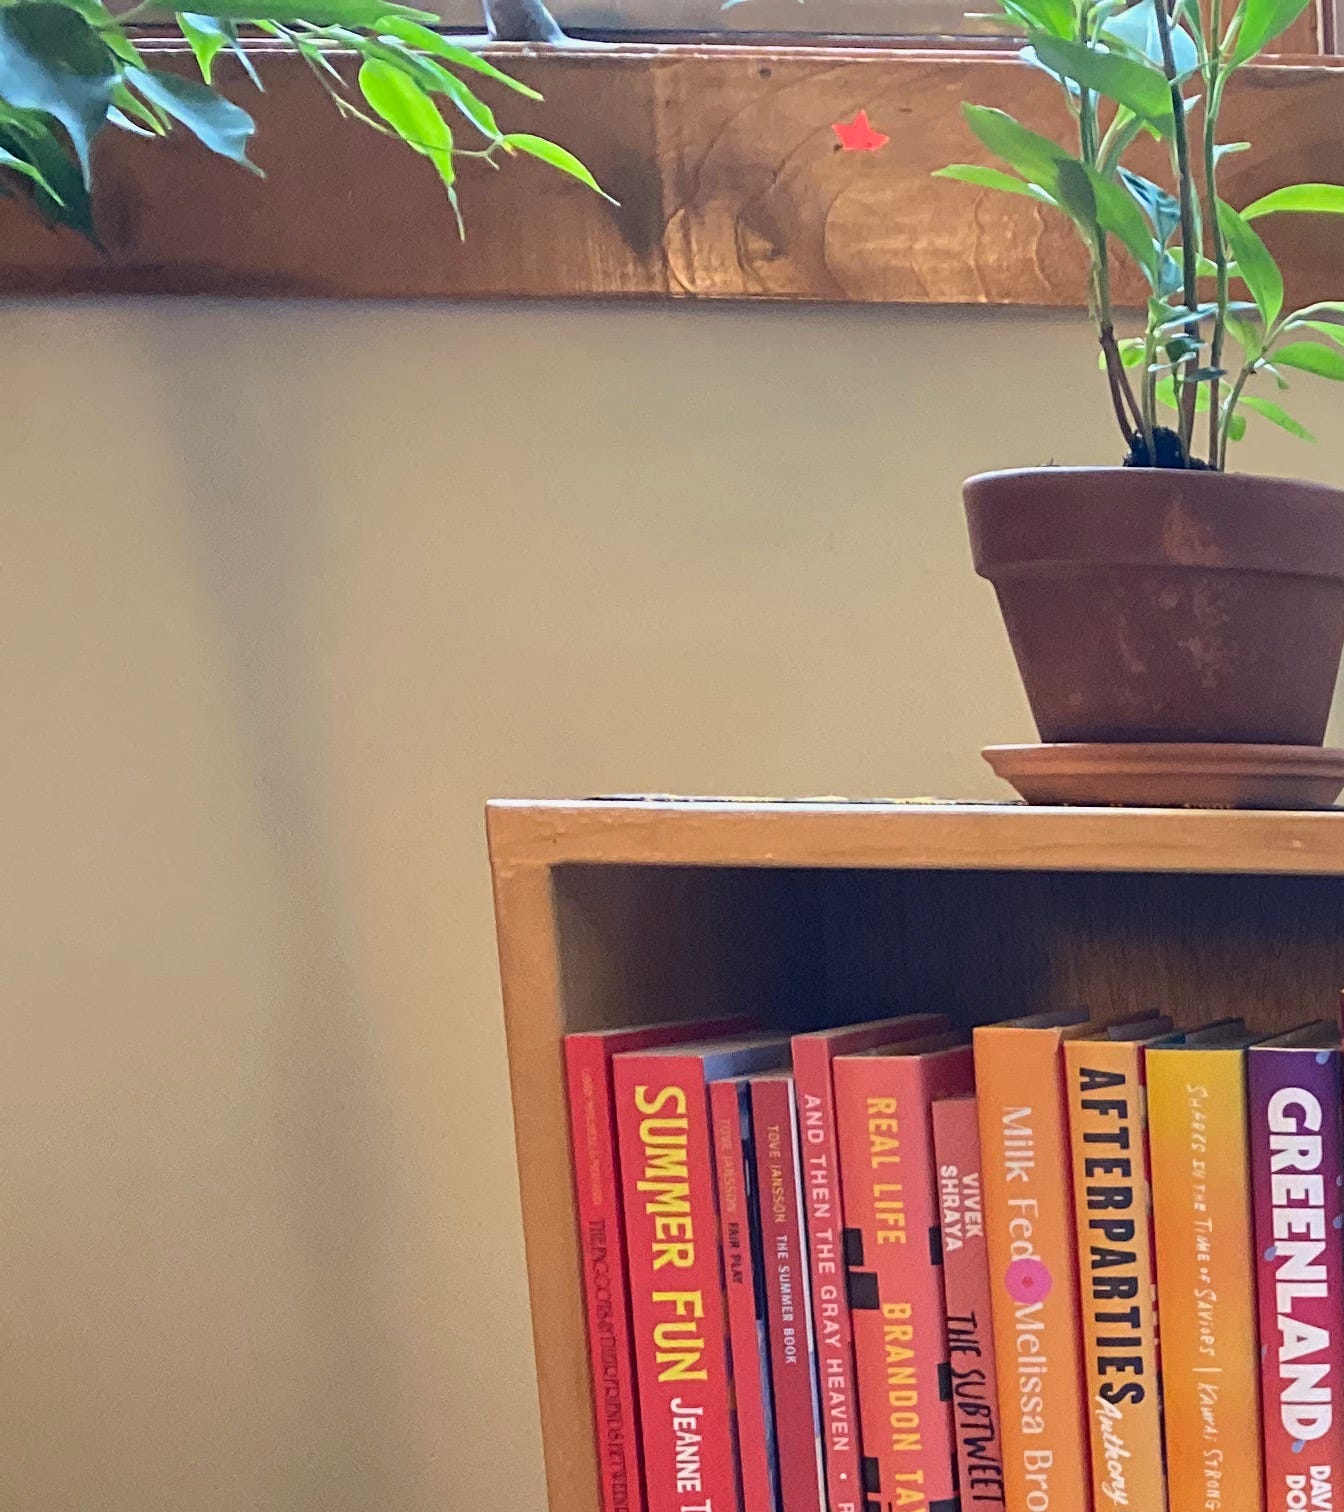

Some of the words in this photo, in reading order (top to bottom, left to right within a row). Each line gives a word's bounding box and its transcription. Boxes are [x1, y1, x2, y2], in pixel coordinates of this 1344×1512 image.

[805, 1094, 822, 1145] AND
[867, 1097, 896, 1168] REAL
[1001, 1105, 1035, 1184] Milk
[635, 1085, 697, 1270] SUMMER
[807, 1155, 830, 1219] THEN
[873, 1183, 906, 1246] LIFE
[941, 1165, 963, 1251] SHRAYA
[963, 1173, 982, 1239] VIVEK
[816, 1226, 834, 1276] THE
[1079, 1065, 1145, 1406] AFTERPARTIES
[1266, 1086, 1335, 1442] GREENLAND
[652, 1291, 707, 1382] FUN
[820, 1280, 841, 1350] GRAY
[827, 1358, 850, 1452] HEAVEN
[881, 1303, 920, 1452] BRANDON
[1016, 1303, 1047, 1436] Melissa
[670, 1397, 702, 1494] JEANNE
